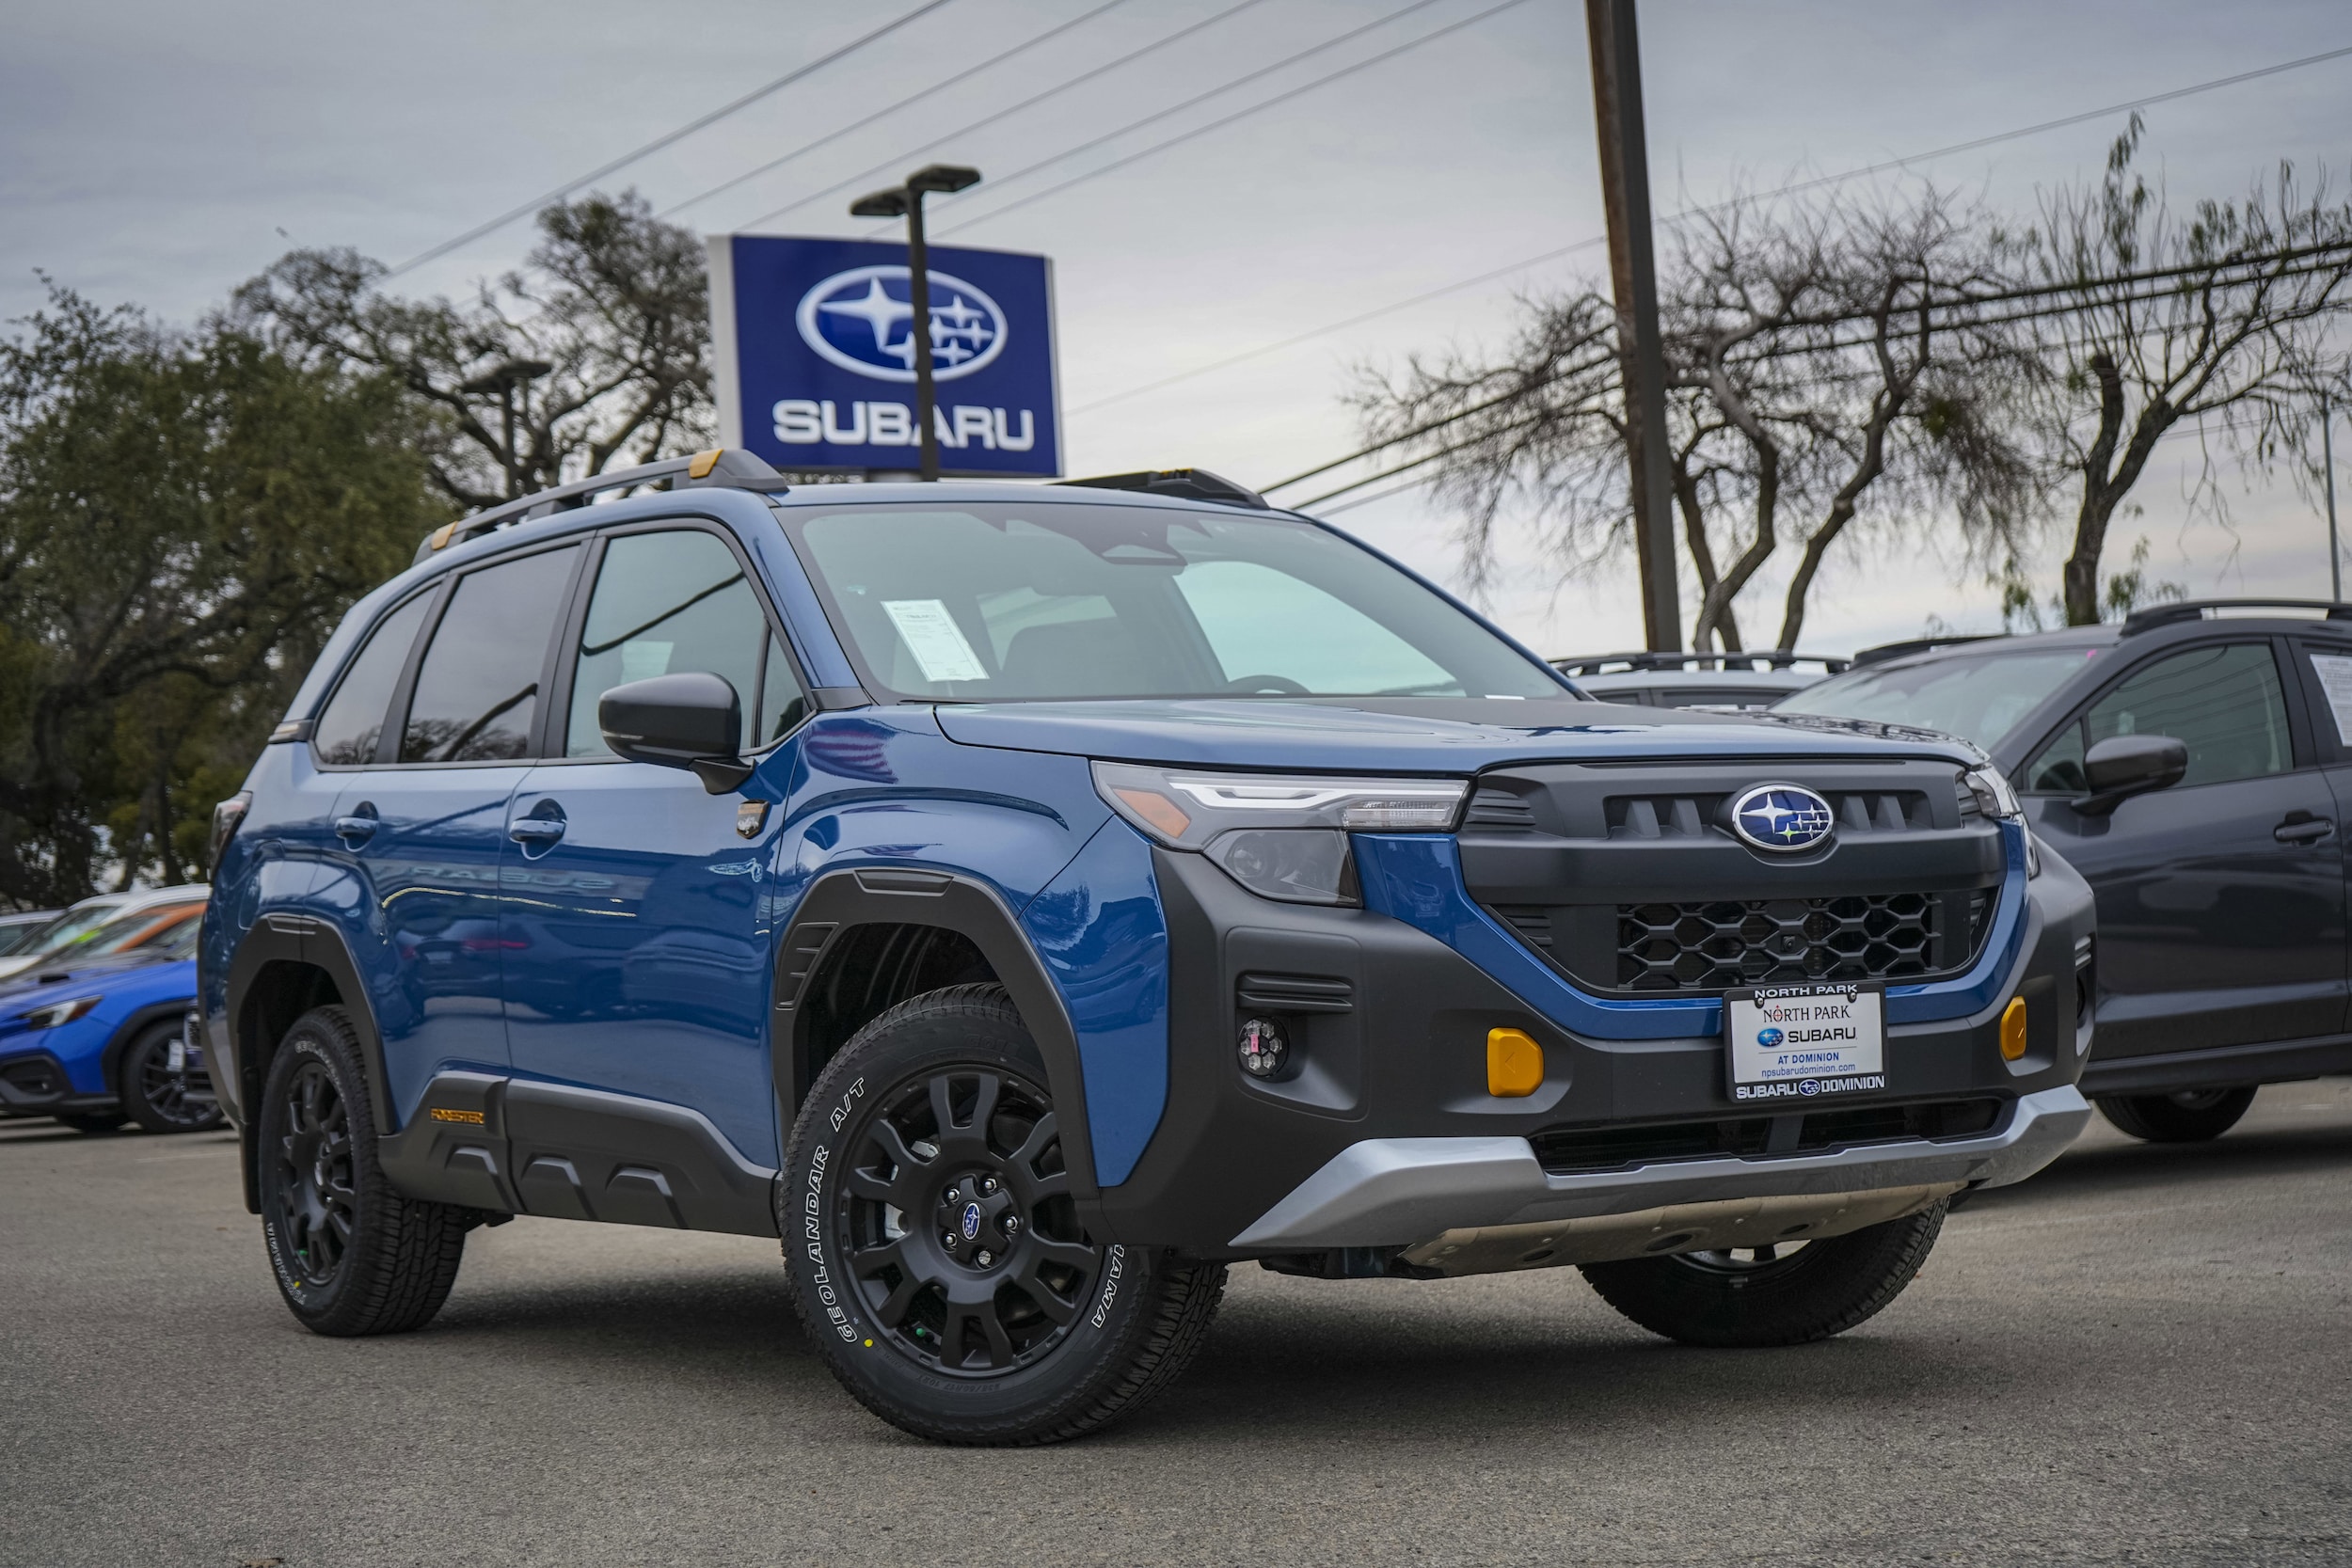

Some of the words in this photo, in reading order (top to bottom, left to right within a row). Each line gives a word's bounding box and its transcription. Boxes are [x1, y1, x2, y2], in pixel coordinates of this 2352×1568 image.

[1755, 987, 1810, 999] NORTH
[1816, 984, 1858, 994] PARK
[1763, 1006, 1810, 1023] NORTH
[1815, 1005, 1851, 1021] PARK
[1788, 1027, 1856, 1043] SUBARU
[1778, 1054, 1788, 1065] AT
[1792, 1052, 1839, 1064] DOMINION
[1761, 1063, 1856, 1079] npsubarudominion.com
[1736, 1082, 1798, 1100] SUBARU
[1821, 1075, 1885, 1094] DOMINION
[830, 1077, 864, 1132] A/T
[805, 1145, 857, 1343] GEOLANDAR
